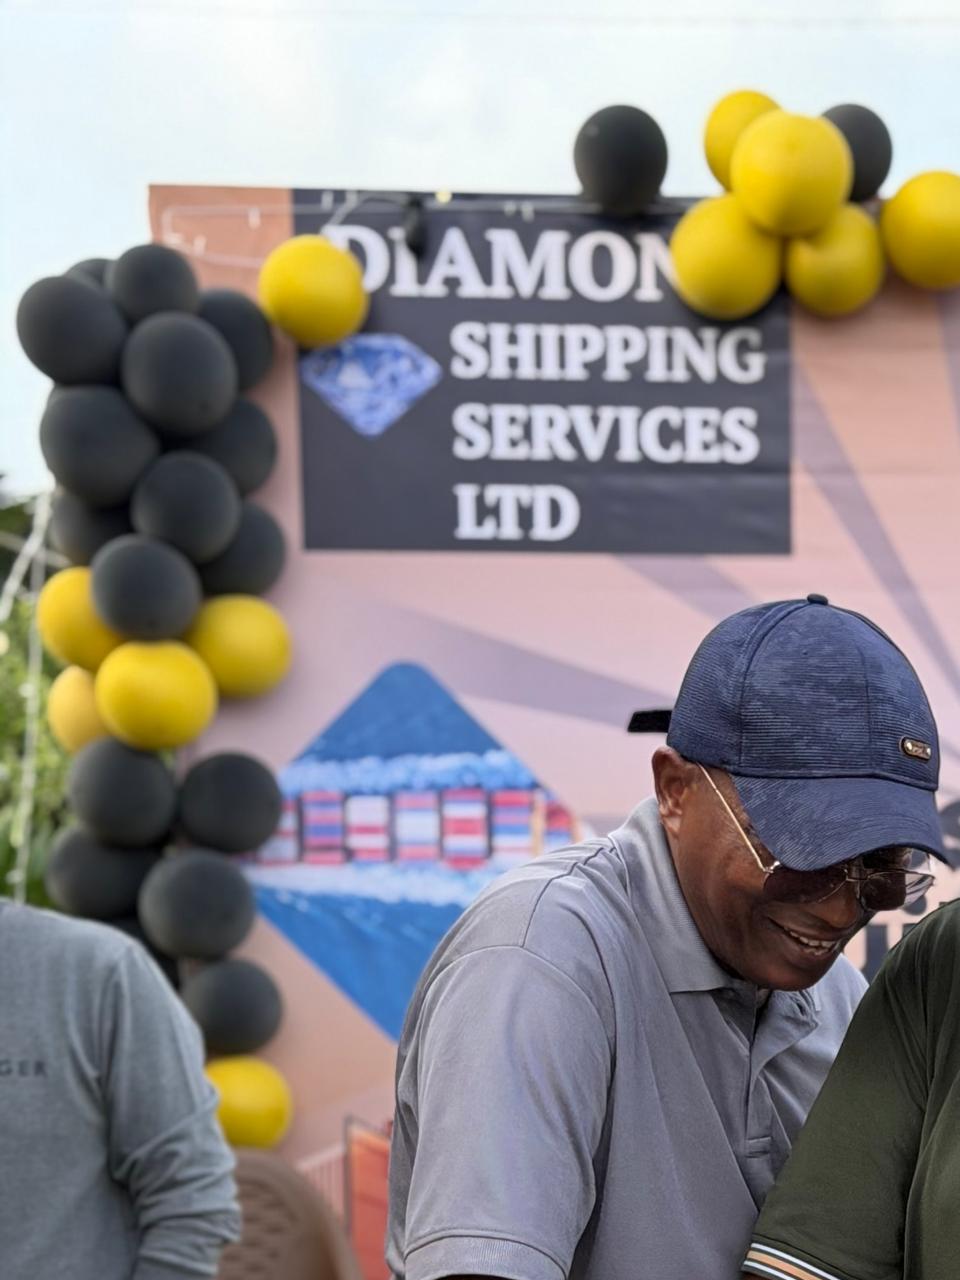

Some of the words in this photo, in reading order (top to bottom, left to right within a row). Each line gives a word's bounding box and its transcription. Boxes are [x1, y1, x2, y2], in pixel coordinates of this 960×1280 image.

[321, 225, 677, 302] DIAMON
[450, 322, 767, 385] SHIPPING
[452, 403, 761, 465] SERVICES
[454, 484, 581, 542] LTD
